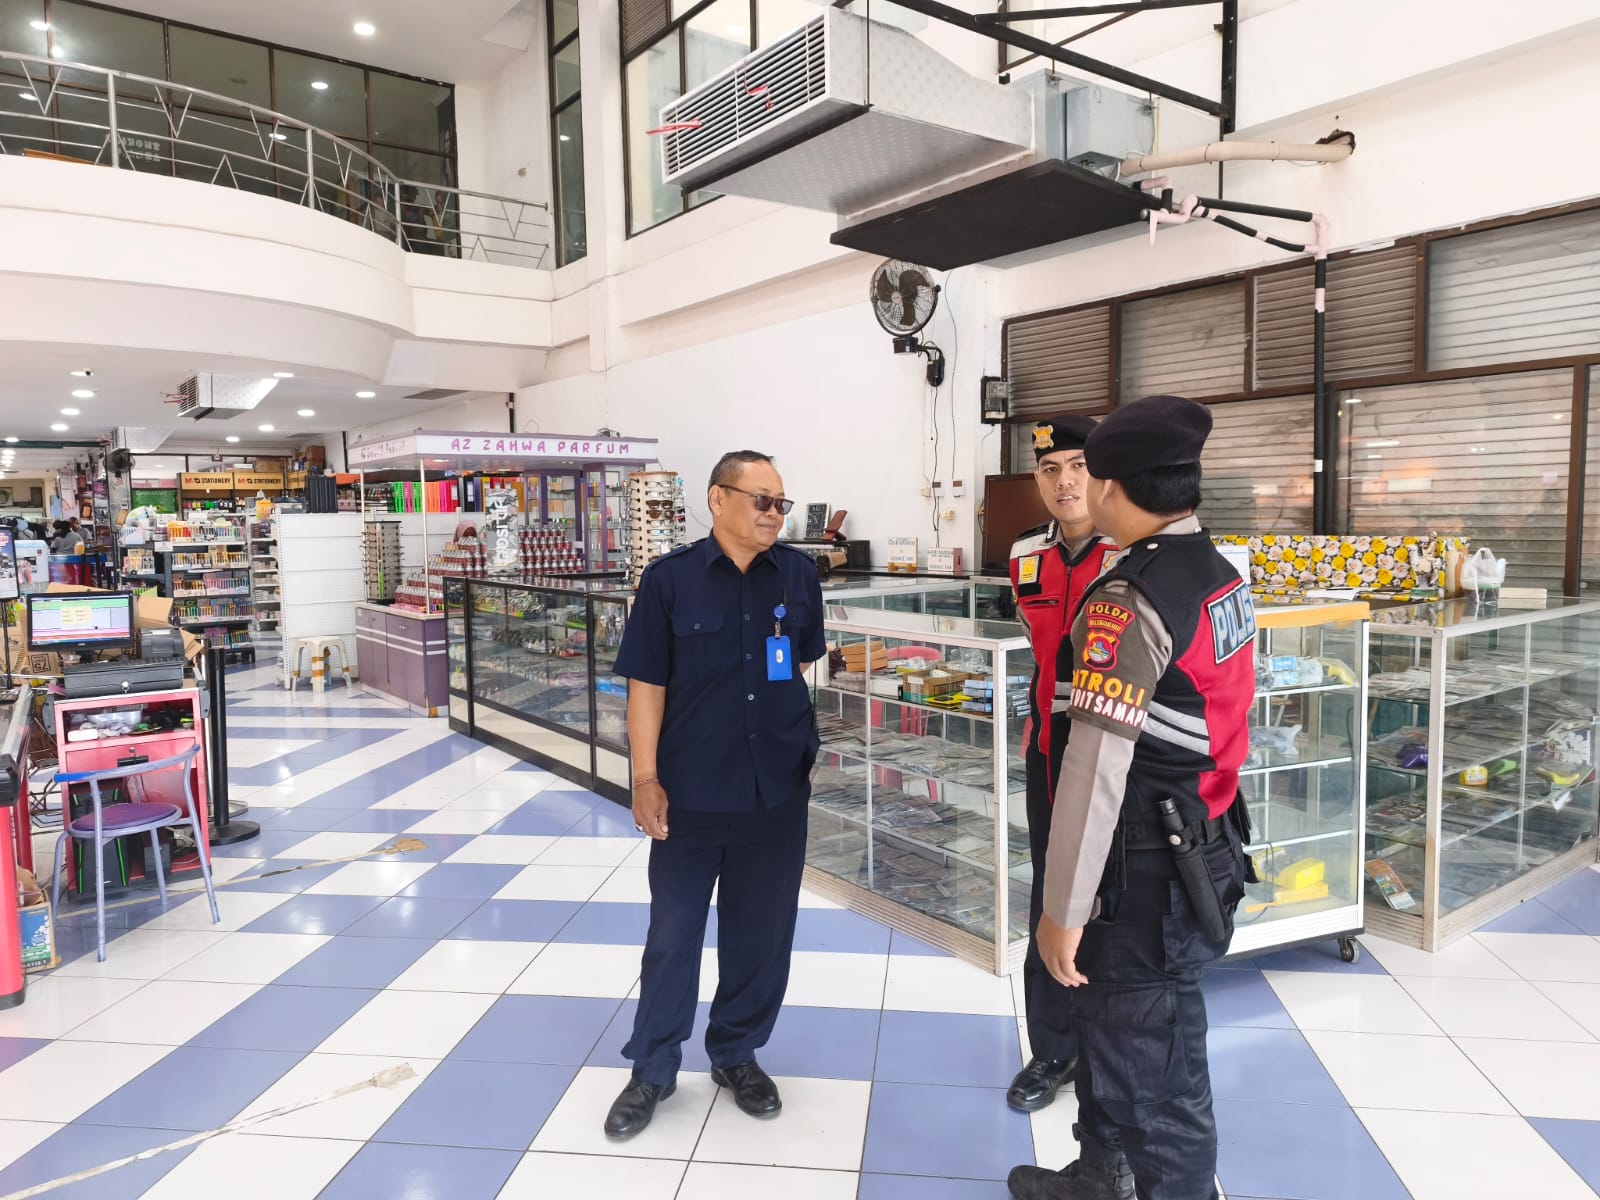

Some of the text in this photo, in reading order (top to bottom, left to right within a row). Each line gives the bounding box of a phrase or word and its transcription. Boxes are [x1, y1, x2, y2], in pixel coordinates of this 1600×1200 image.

[451, 438, 629, 454] AZ ZAHWA PARFUM
[1089, 605, 1130, 622] POLDA
[1072, 669, 1146, 707] ATROLI
